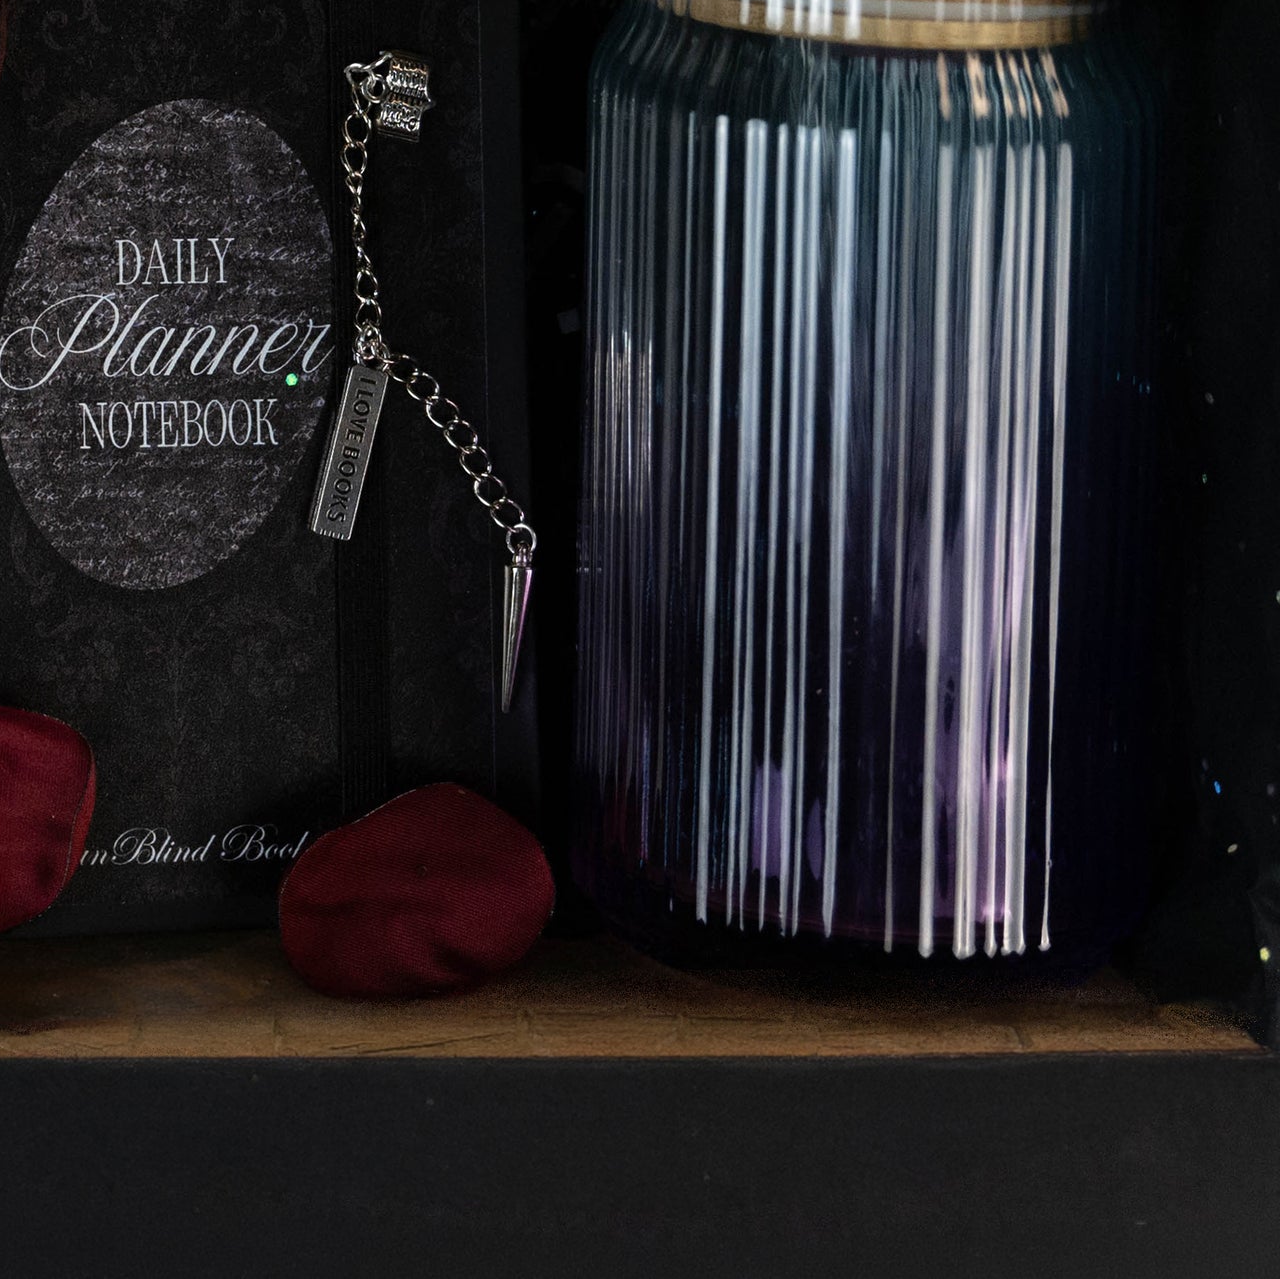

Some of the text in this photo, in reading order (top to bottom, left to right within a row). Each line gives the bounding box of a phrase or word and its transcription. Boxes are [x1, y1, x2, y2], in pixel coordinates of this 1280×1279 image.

[114, 237, 234, 285] DAILY
[78, 398, 279, 450] NOTEBOOK
[326, 377, 377, 524] I LOVE BOOKS
